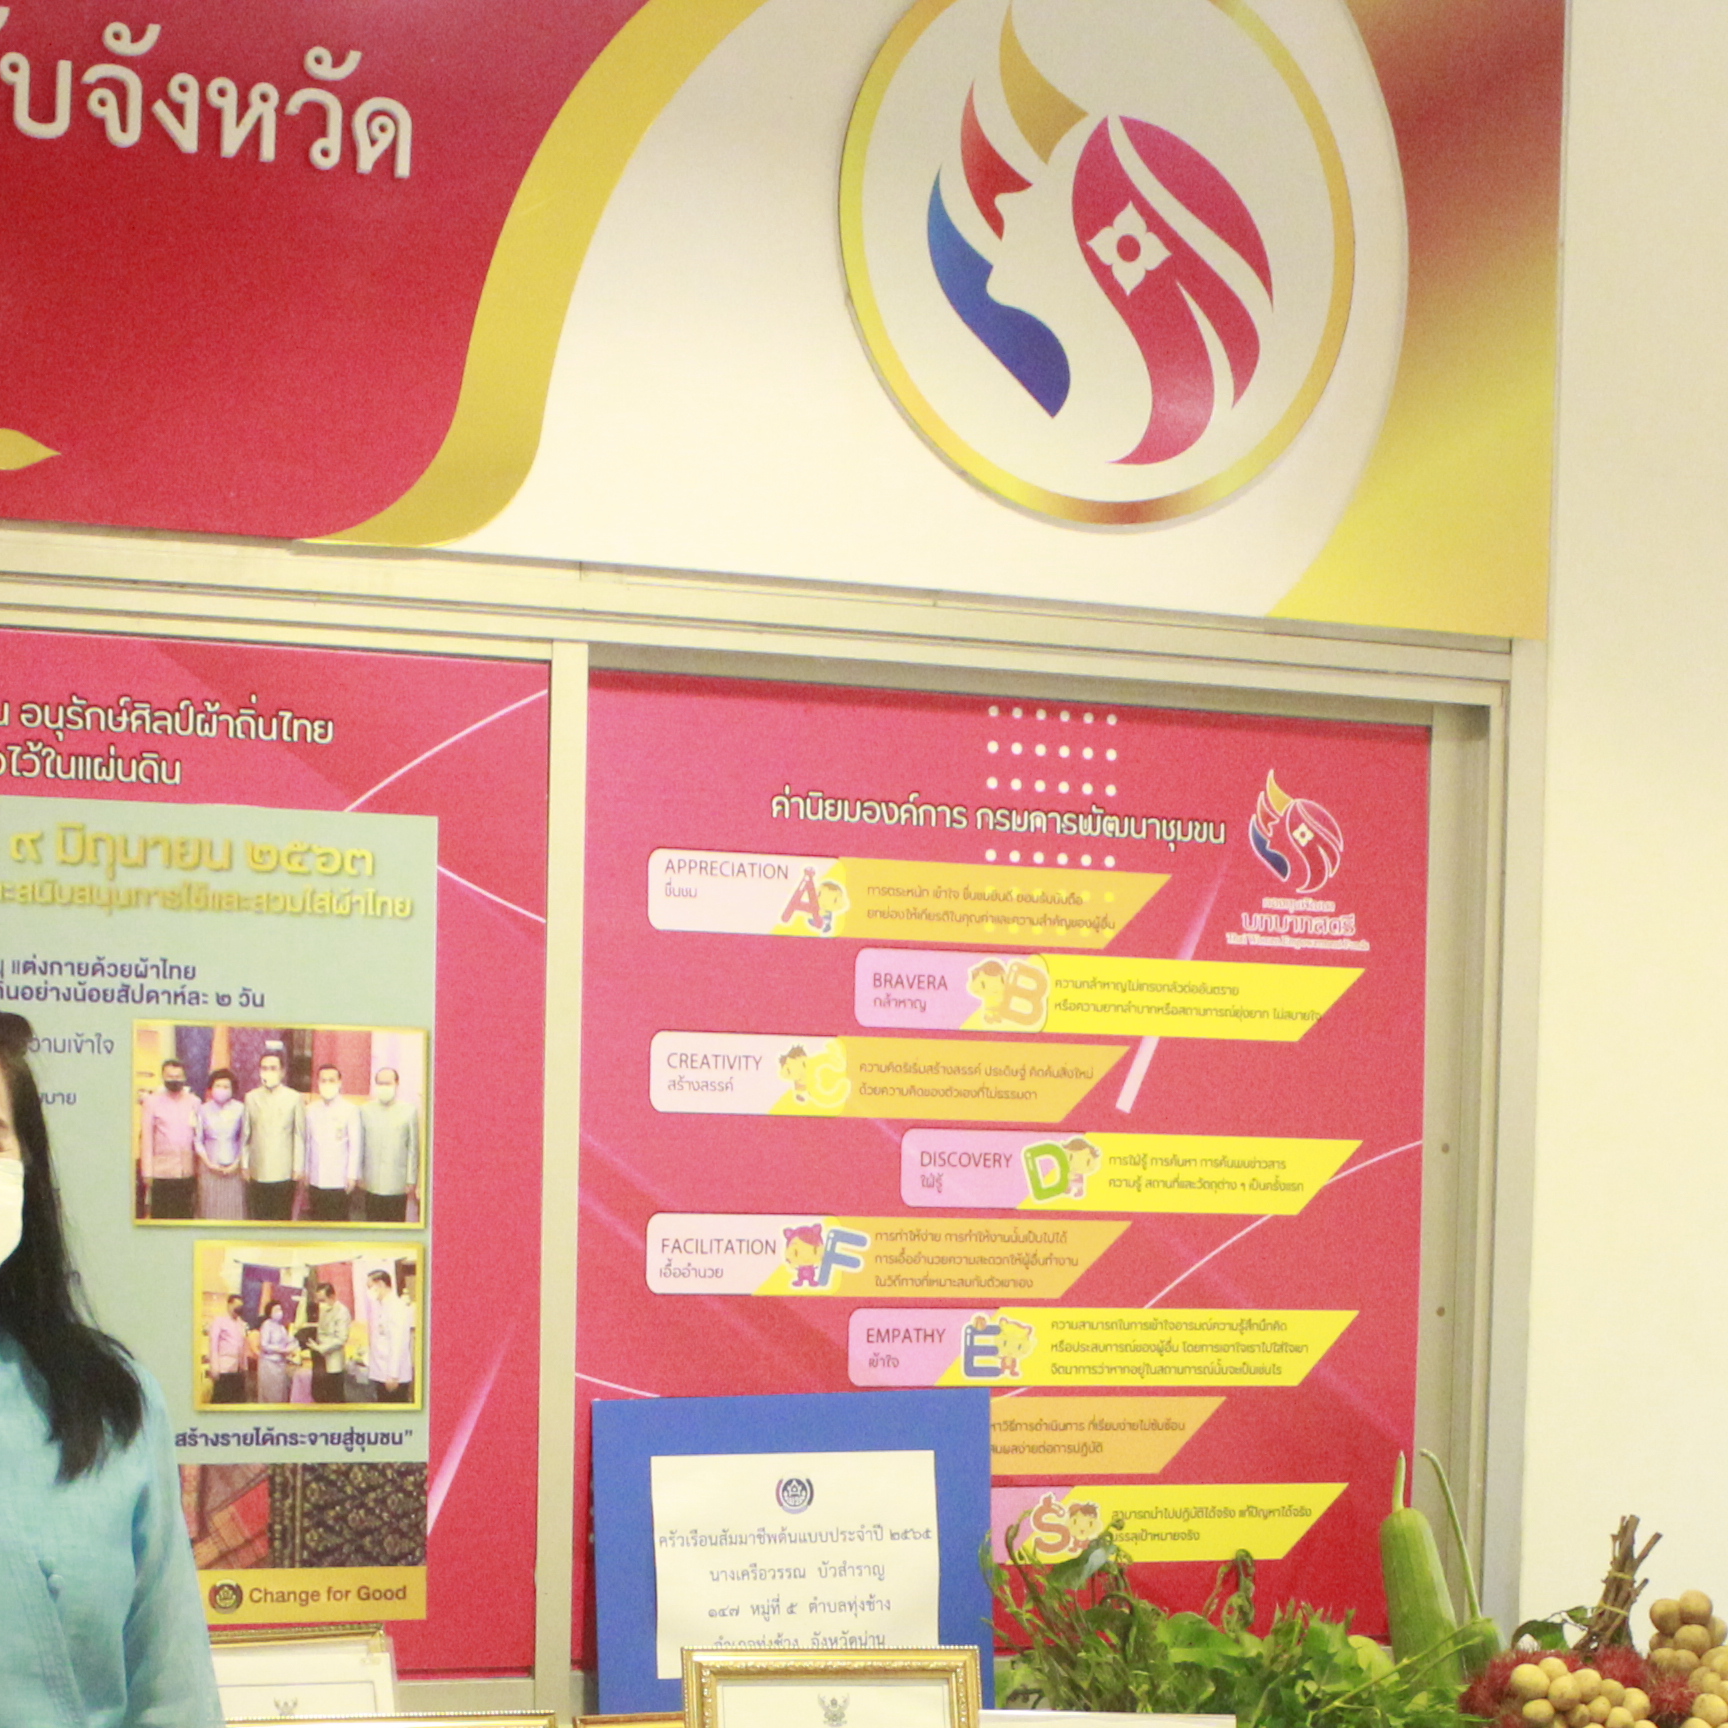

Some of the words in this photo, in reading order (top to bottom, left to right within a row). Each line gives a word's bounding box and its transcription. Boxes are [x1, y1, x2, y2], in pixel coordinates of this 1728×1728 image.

[19, 694, 335, 745] อนุรักษ์ศิลป์ผ้าถิ่นไทย
[771, 784, 968, 829] ค่านิยมองค์การ
[54, 824, 234, 880] มิถุนายน
[664, 858, 790, 880] APPRECIATION
[11, 954, 197, 982] แต่งกายด้วยผ้าไทย
[872, 972, 949, 992] BRAVERA
[238, 985, 266, 1009] วัน
[873, 994, 928, 1013] กล้าหาญ
[27, 1032, 115, 1055] วามเข้าใจ
[667, 1052, 763, 1071] CREATIVITY
[667, 1074, 735, 1092] สร้างสรรค์
[920, 1151, 1013, 1168] DISCOVERY
[661, 1238, 777, 1255] FACILITATION
[659, 1258, 724, 1279] เอื้ออำนวย
[866, 1328, 947, 1344] EMPATHY
[868, 1352, 900, 1368] เข้าใจ
[658, 1523, 884, 1549] ครัวเรือนสัมมาชีพต้นแบบประจำปี
[709, 1563, 807, 1583] นางเครือวรรณ
[817, 1560, 886, 1581] บัวสำราญ
[248, 1587, 321, 1607] Change
[327, 1585, 352, 1601] for
[356, 1585, 408, 1601] Good
[750, 1594, 781, 1622] หมู่ที่
[808, 1594, 892, 1617] ตำบลทุ่งช้าง
